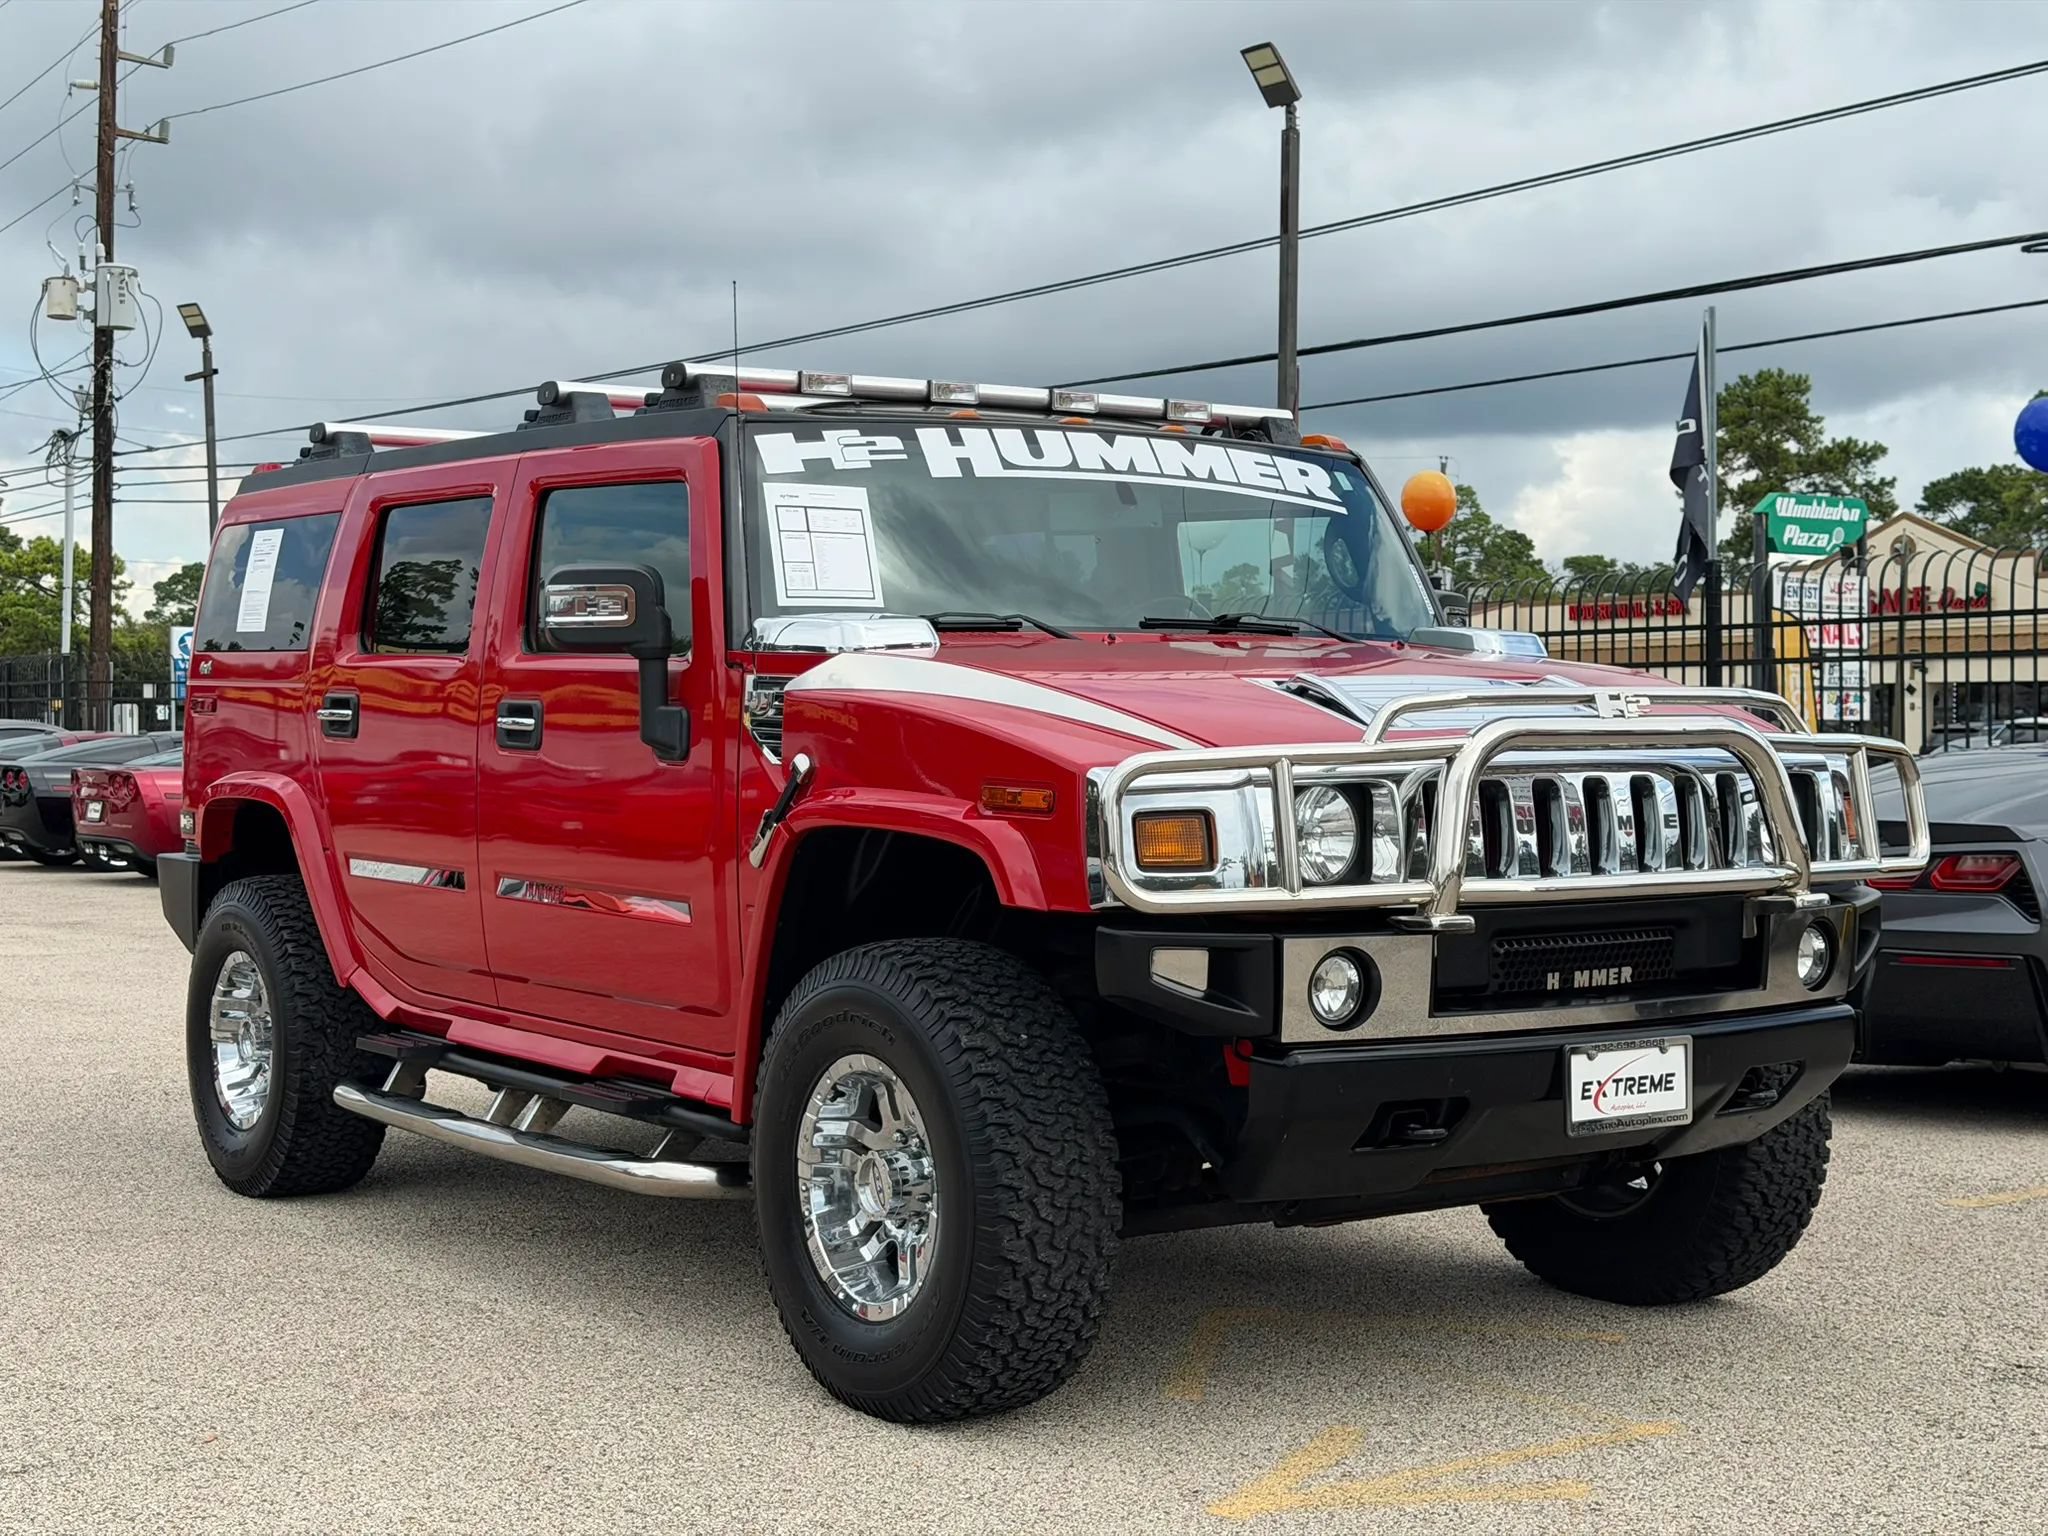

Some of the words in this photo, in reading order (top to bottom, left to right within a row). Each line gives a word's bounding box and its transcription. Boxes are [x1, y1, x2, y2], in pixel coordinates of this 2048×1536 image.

[754, 428, 908, 475] H2
[915, 427, 1346, 508] HUMMER
[1775, 497, 1861, 522] Wimbledon
[1783, 524, 1830, 548] Plaza
[1580, 1072, 1676, 1101] EXTREME
